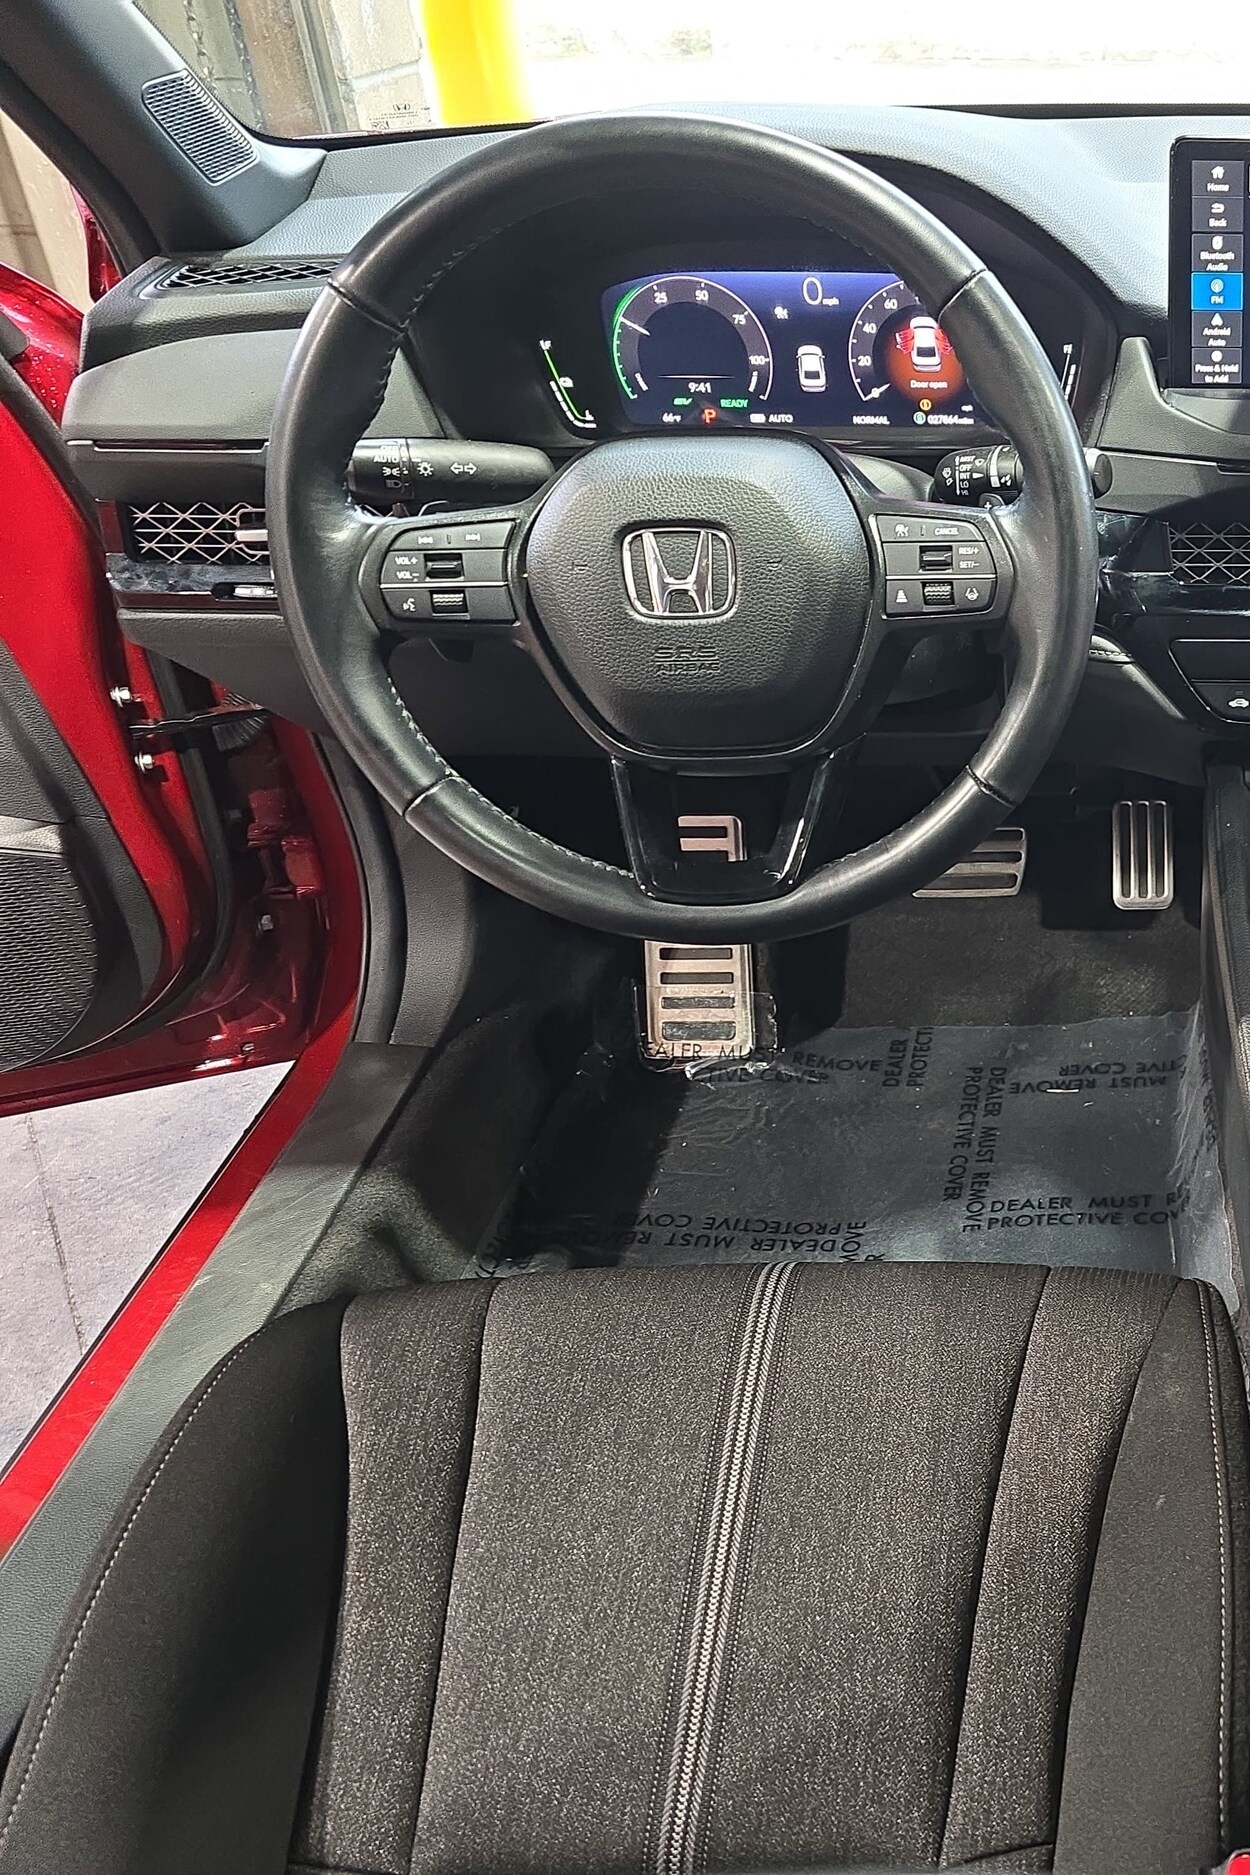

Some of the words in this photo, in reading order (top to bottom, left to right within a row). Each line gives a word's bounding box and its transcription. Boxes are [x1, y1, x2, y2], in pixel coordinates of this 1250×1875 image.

[1207, 183, 1229, 192] Home
[1209, 218, 1227, 228] Back
[1200, 251, 1235, 260] Bluetooth
[1207, 263, 1228, 271] Audio
[695, 290, 708, 300] 50
[803, 277, 823, 305] 0
[654, 292, 667, 303] 25
[1210, 295, 1224, 304] FM
[884, 299, 897, 309] 60
[732, 314, 746, 325] 75
[862, 323, 876, 334] 40
[1203, 327, 1231, 336] Android
[1208, 338, 1226, 347] Auto
[749, 355, 765, 365] 100
[858, 356, 871, 366] 20
[688, 382, 711, 393] 9:41
[910, 380, 928, 388] Door
[929, 381, 947, 390] open
[720, 399, 748, 407] READY
[704, 409, 716, 423] P
[768, 414, 793, 422] AUTO
[853, 416, 890, 424] NORMAL
[373, 454, 399, 462] AUTO
[646, 1042, 703, 1059] EALER
[793, 1053, 880, 1072] REMOVE
[882, 1039, 909, 1087] DEALER
[1059, 1062, 1126, 1076] COVER
[1009, 1077, 1097, 1094] REMOVE
[1109, 1076, 1166, 1088] MUST
[983, 1067, 1007, 1117] DEALER
[953, 1067, 984, 1150] PROTECTIVE
[976, 1126, 998, 1163] MUST
[943, 1154, 968, 1201] COVER
[962, 1172, 990, 1233] REMOVE
[990, 1197, 1072, 1212] DEALER
[1088, 1194, 1154, 1208] MUST
[703, 1215, 842, 1235] PROTECTIVE
[987, 1212, 1128, 1230] PROTECTIVE
[664, 1233, 735, 1249] MUST
[750, 1236, 837, 1252] DEALER
